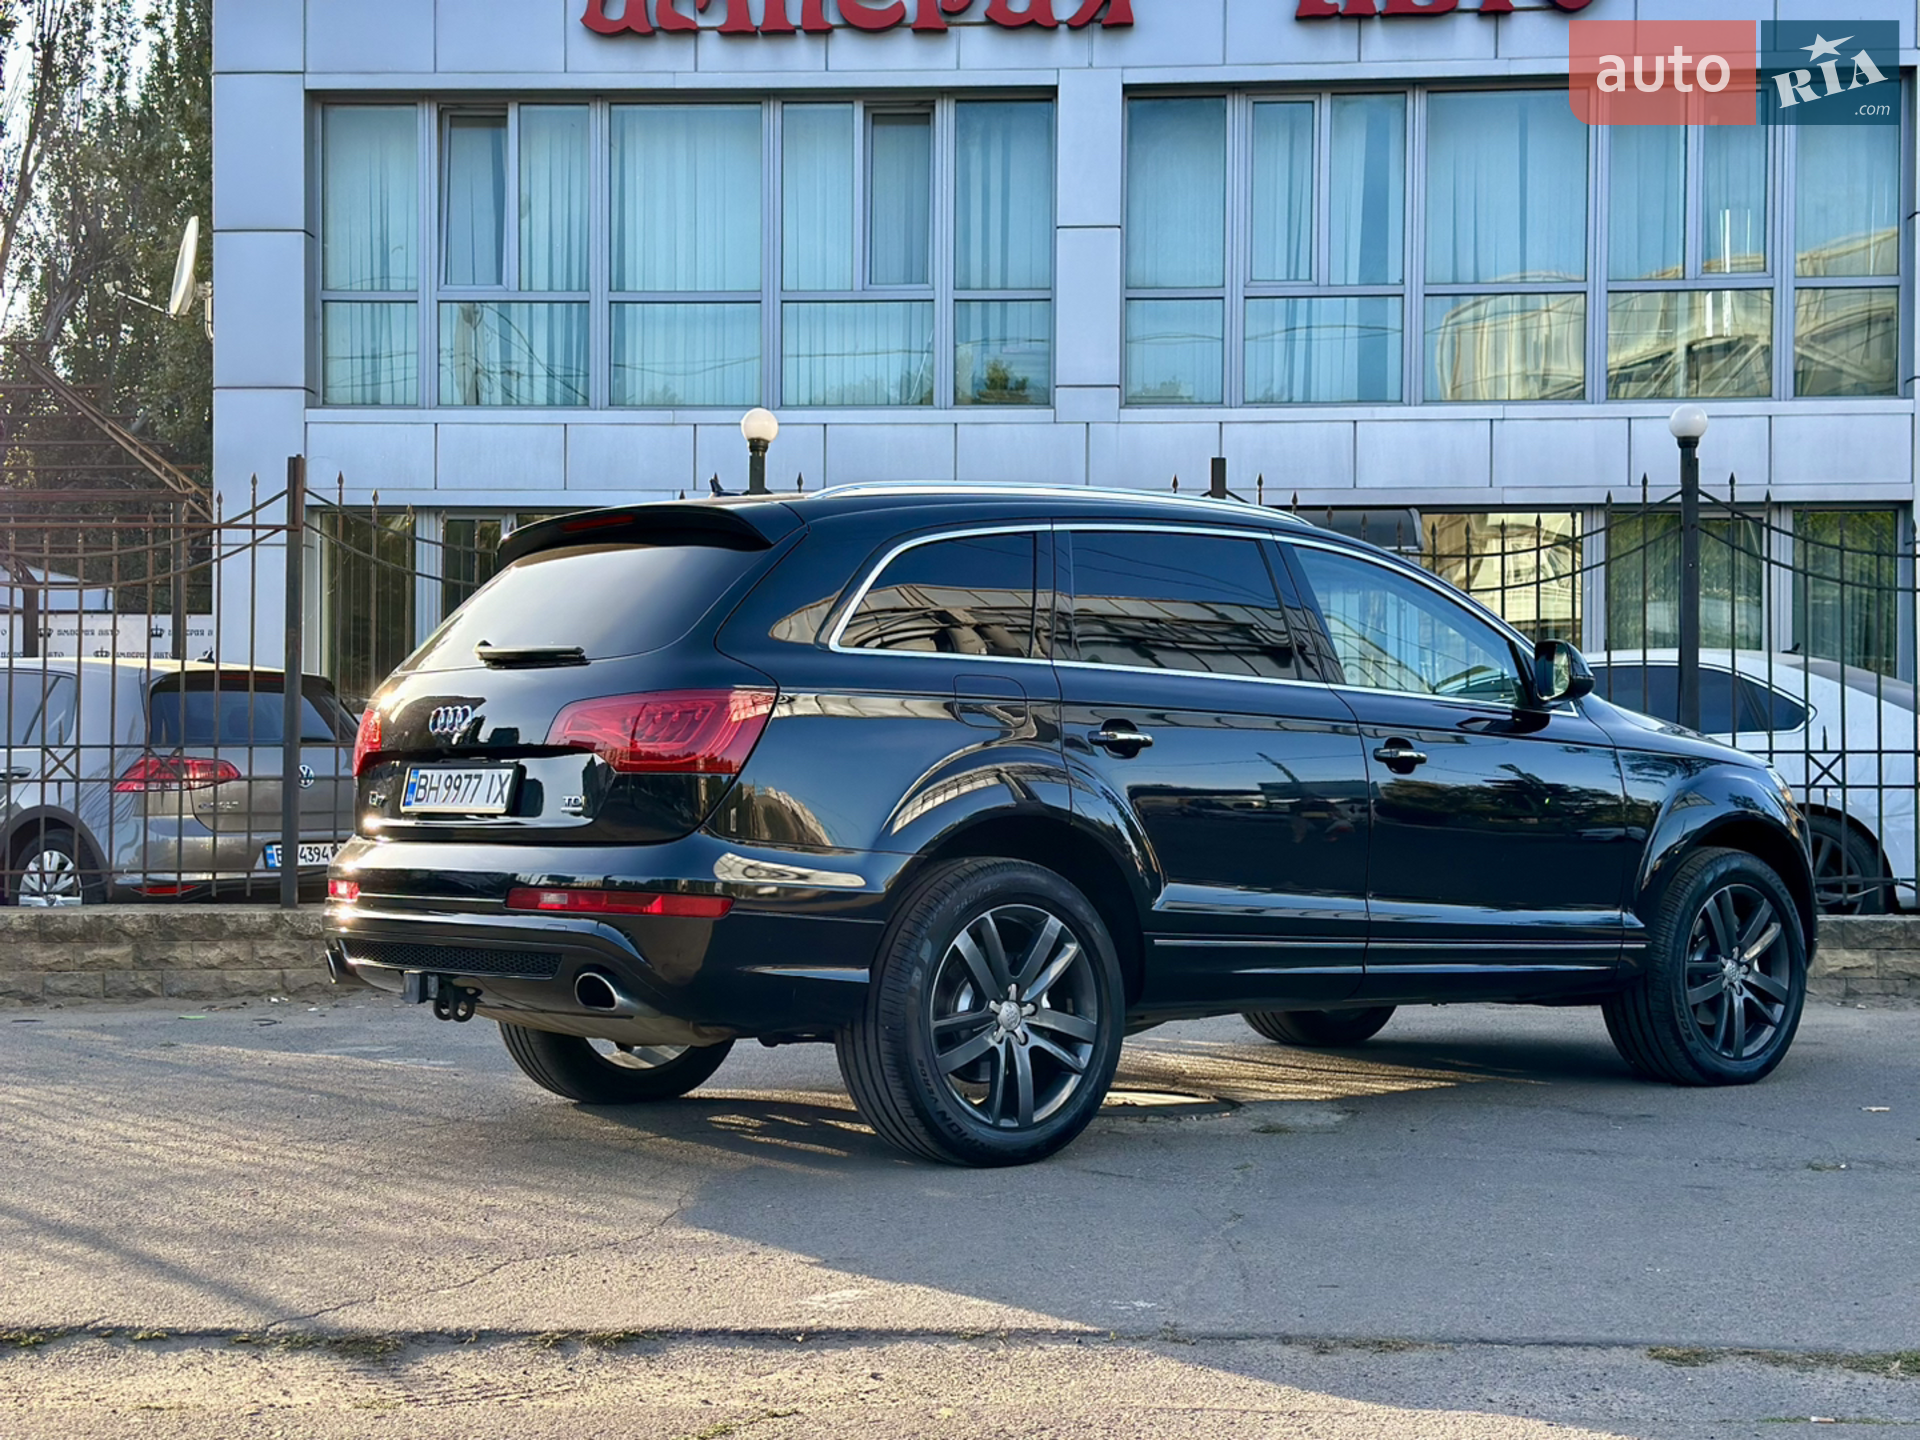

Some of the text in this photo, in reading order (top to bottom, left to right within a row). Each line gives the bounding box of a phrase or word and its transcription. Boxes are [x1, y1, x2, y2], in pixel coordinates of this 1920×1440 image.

[415, 774, 511, 803] BH 9977 IX
[562, 795, 585, 808] TDI
